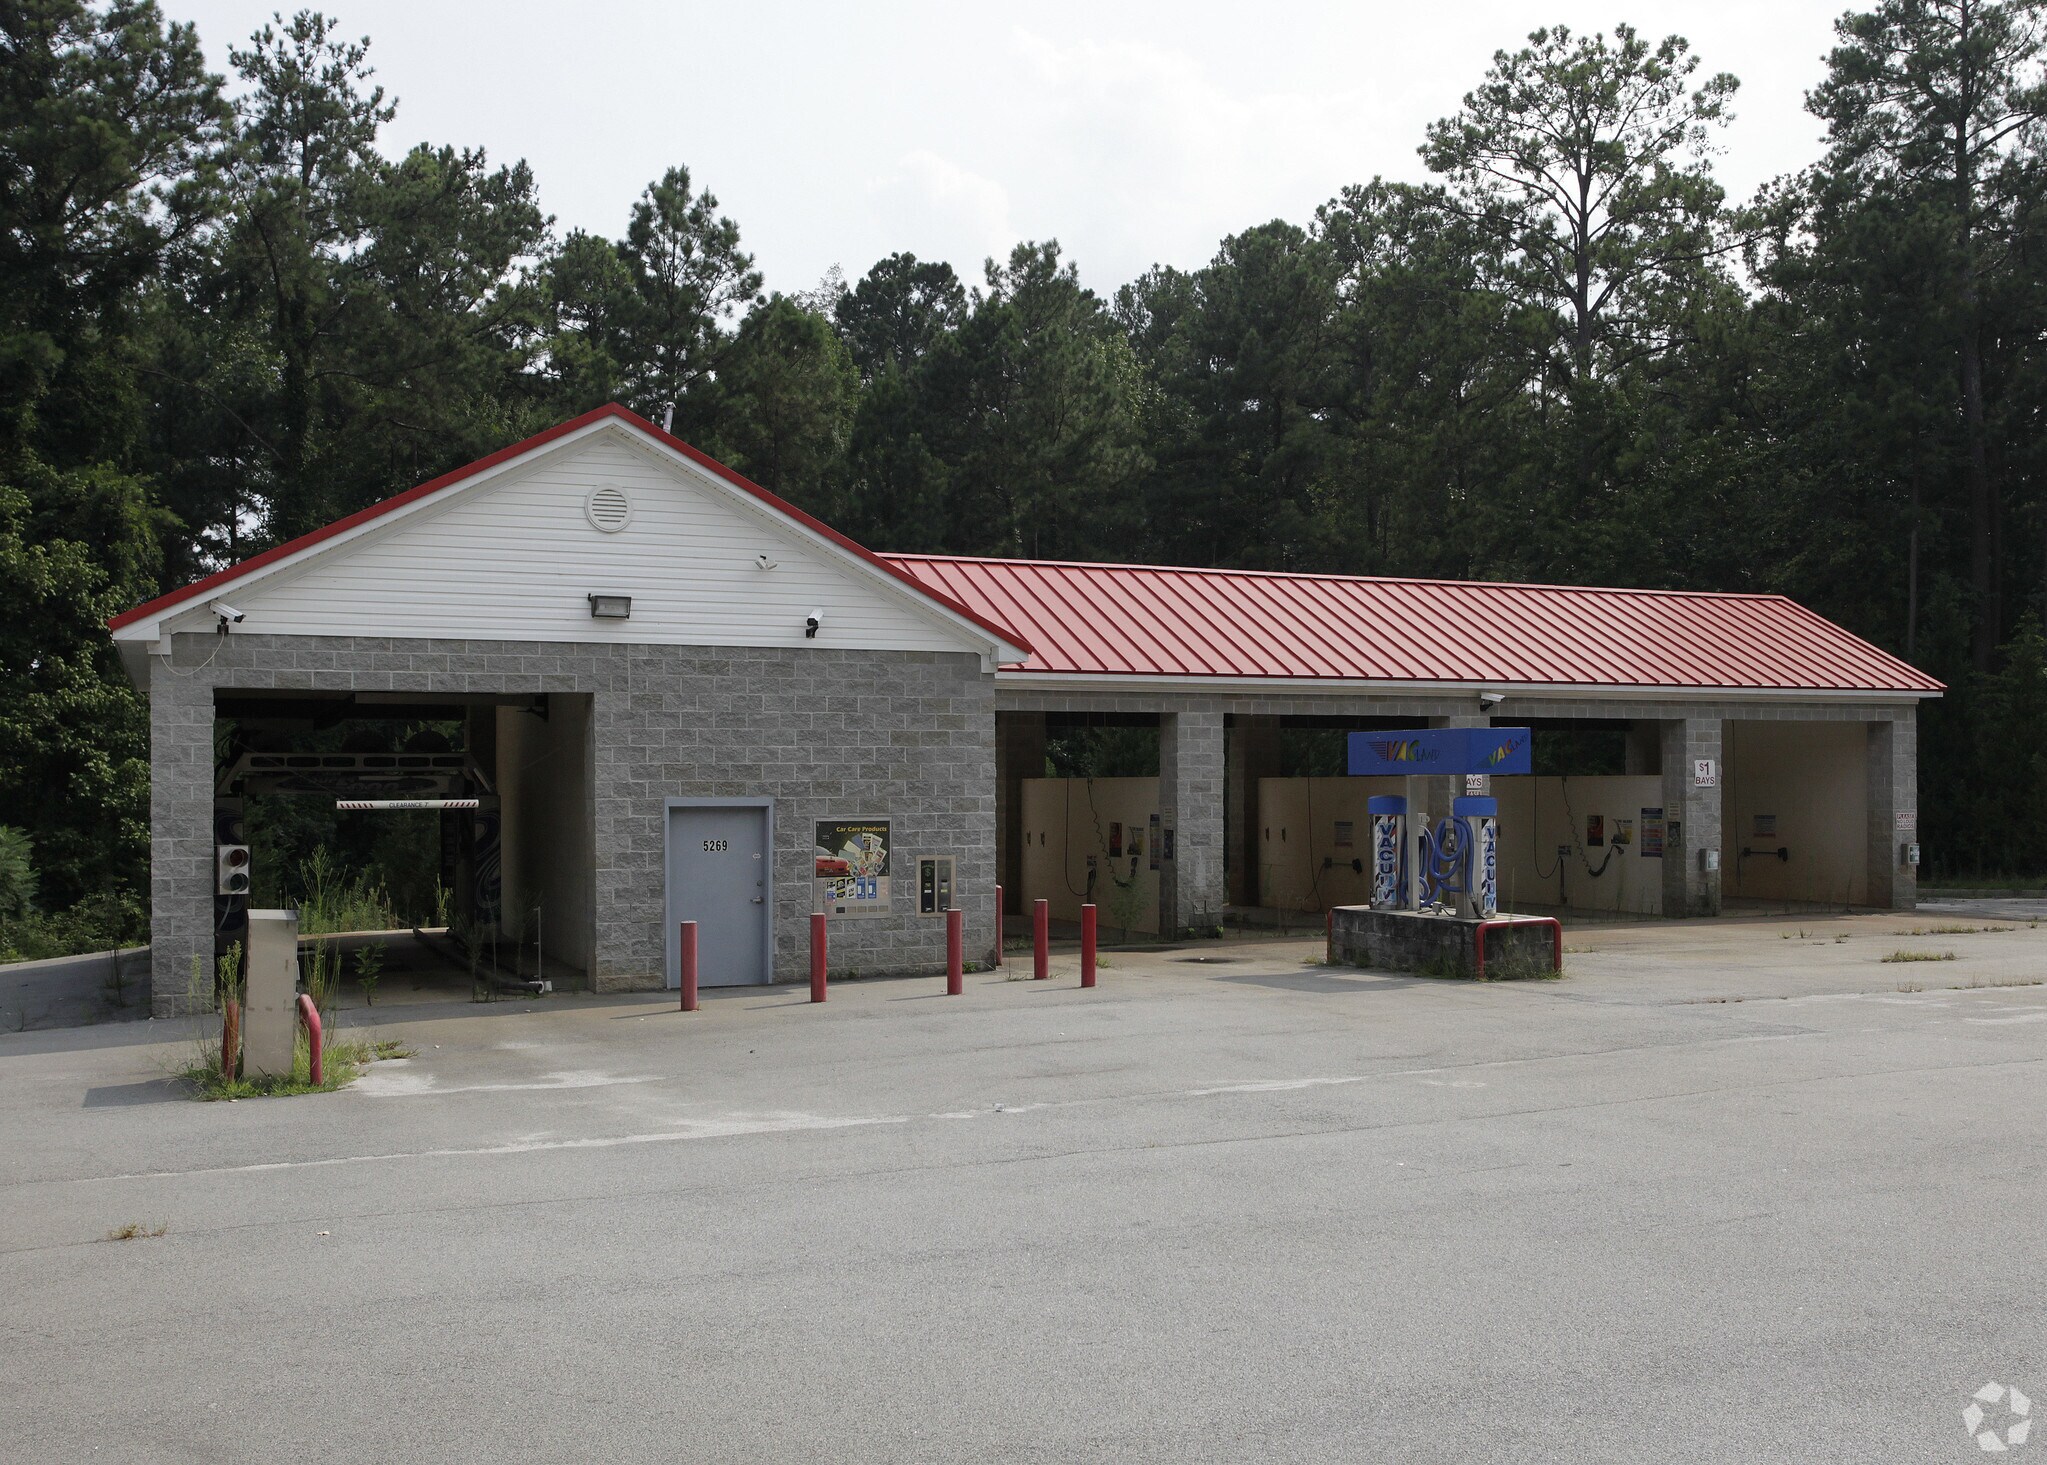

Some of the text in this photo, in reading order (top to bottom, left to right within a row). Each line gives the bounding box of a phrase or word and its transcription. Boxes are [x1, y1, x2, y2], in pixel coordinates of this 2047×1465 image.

[1699, 762, 1709, 775] $1
[1466, 778, 1482, 786] AYS
[1695, 776, 1715, 785] BAYS
[703, 840, 728, 851] 5269
[1379, 824, 1397, 904] VACUUM
[1485, 827, 1496, 910] VACUUM
